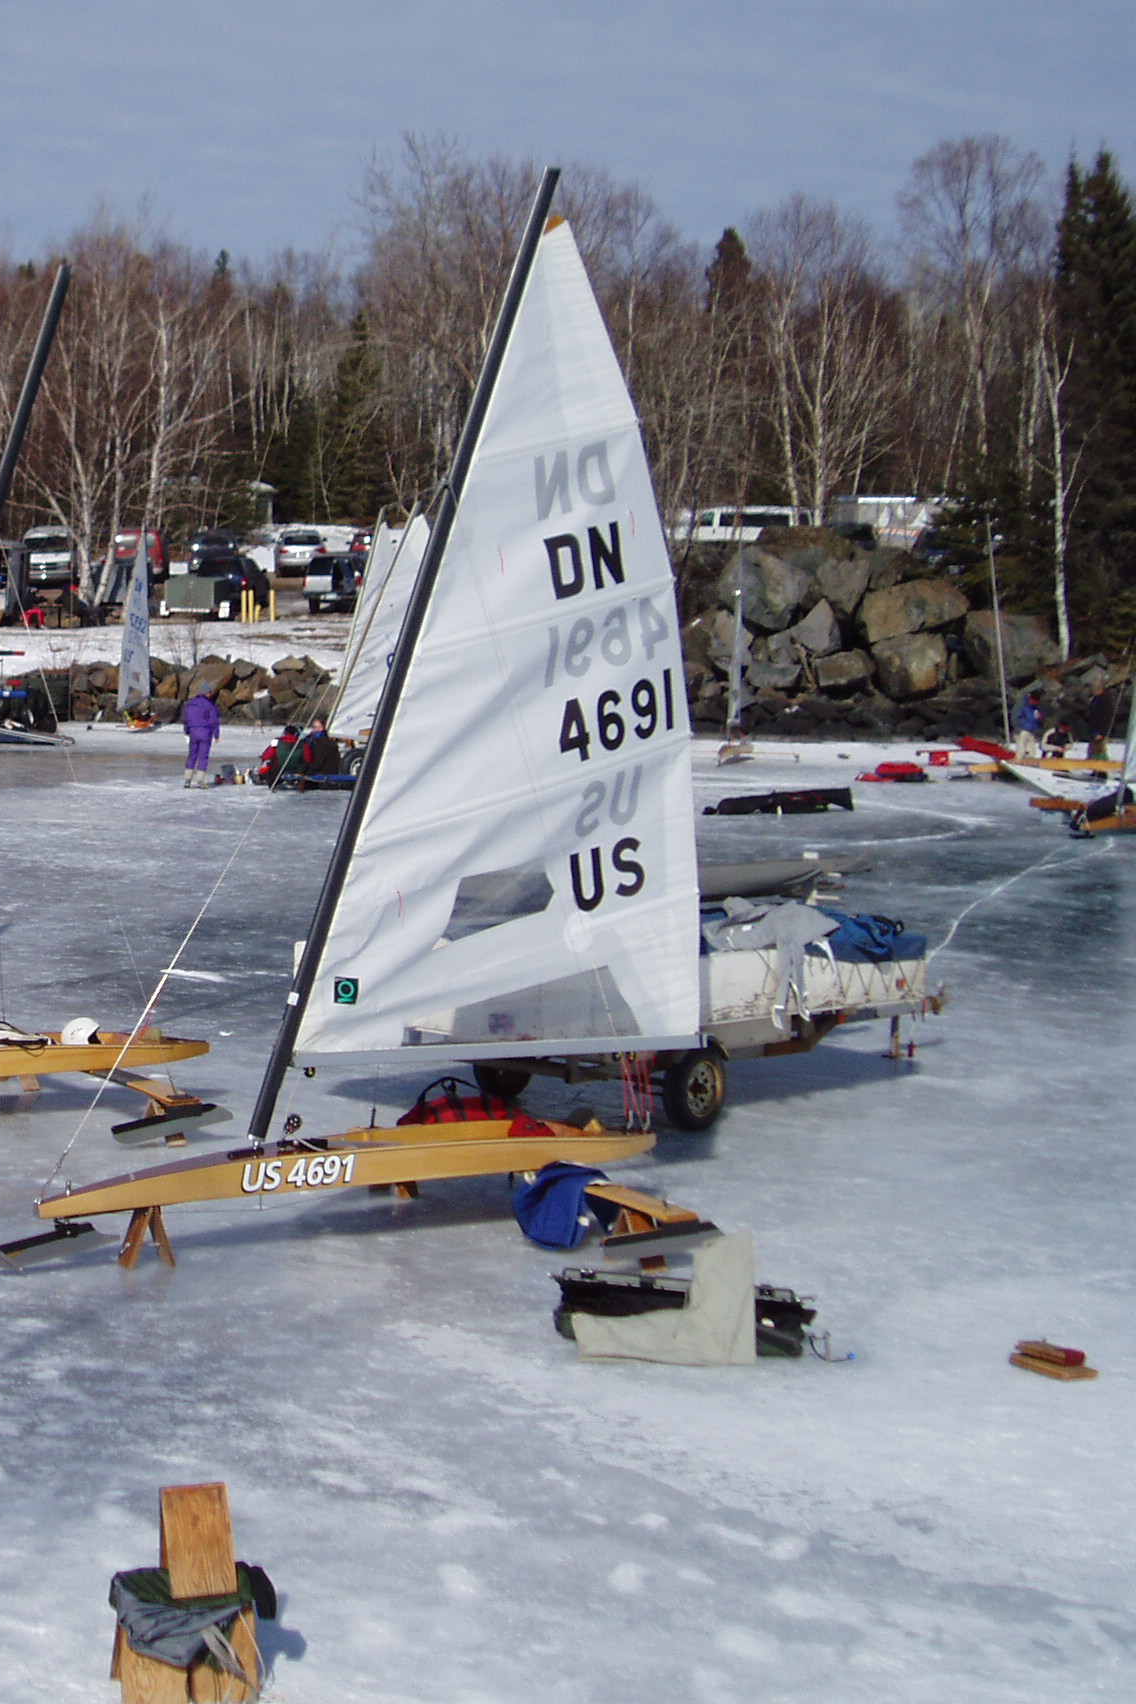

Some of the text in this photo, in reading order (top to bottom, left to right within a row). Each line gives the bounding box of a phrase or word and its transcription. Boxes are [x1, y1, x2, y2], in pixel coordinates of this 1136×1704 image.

[543, 520, 626, 600] DN
[559, 668, 675, 762] 4691
[570, 837, 645, 912] US
[242, 1152, 356, 1194] US 4691
